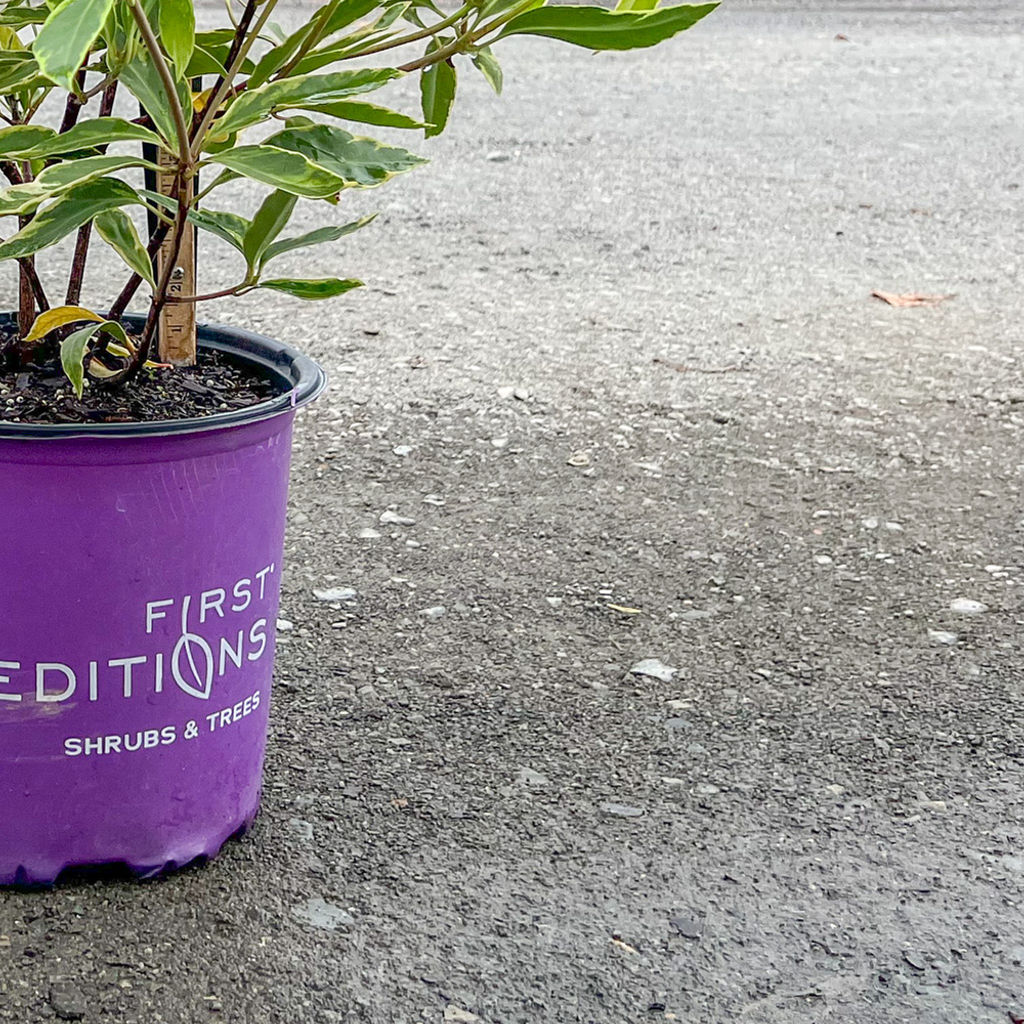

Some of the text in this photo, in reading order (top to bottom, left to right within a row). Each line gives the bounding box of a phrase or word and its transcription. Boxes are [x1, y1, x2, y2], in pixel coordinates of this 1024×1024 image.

[64, 690, 261, 756] SHRUBS & TREES
